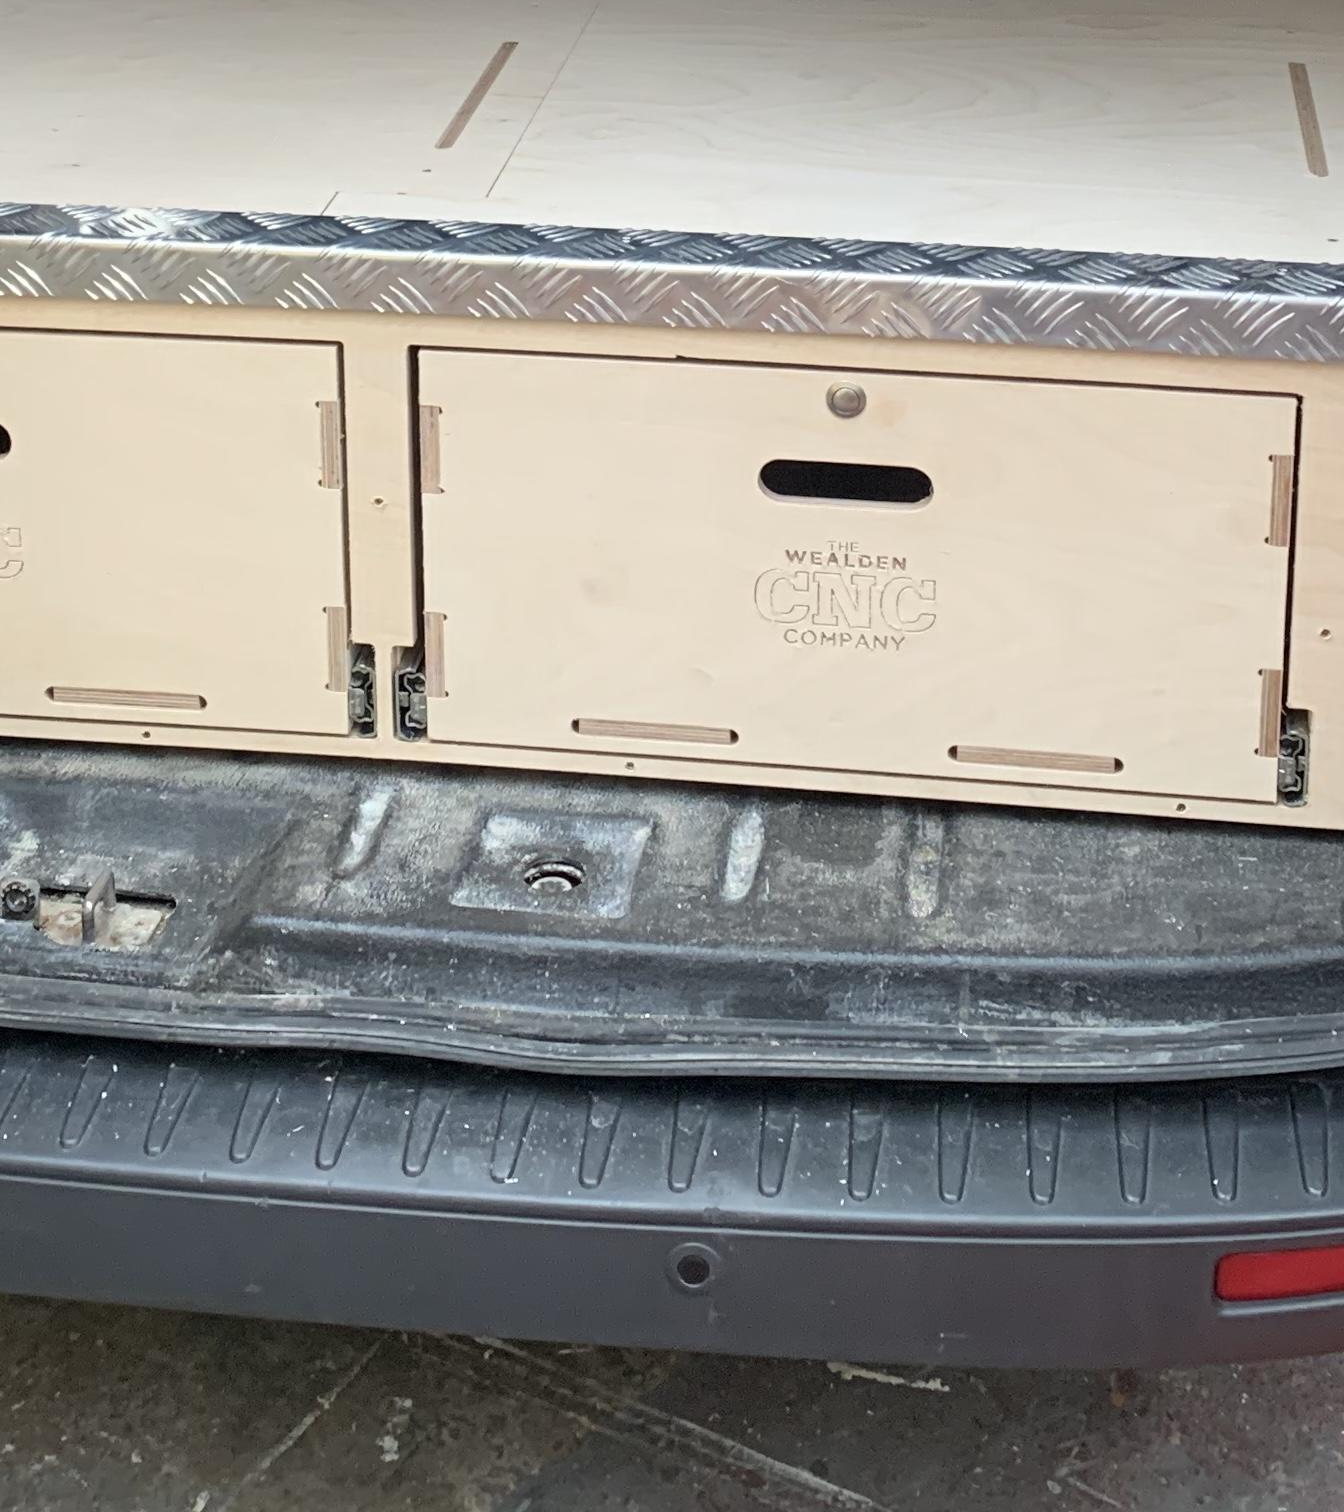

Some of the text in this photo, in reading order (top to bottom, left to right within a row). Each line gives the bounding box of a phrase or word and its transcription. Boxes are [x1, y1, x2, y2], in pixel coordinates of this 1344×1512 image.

[827, 540, 859, 553] THE
[785, 549, 906, 570] WEALDEN
[754, 568, 936, 632] CNC
[784, 629, 905, 650] COMPANY
